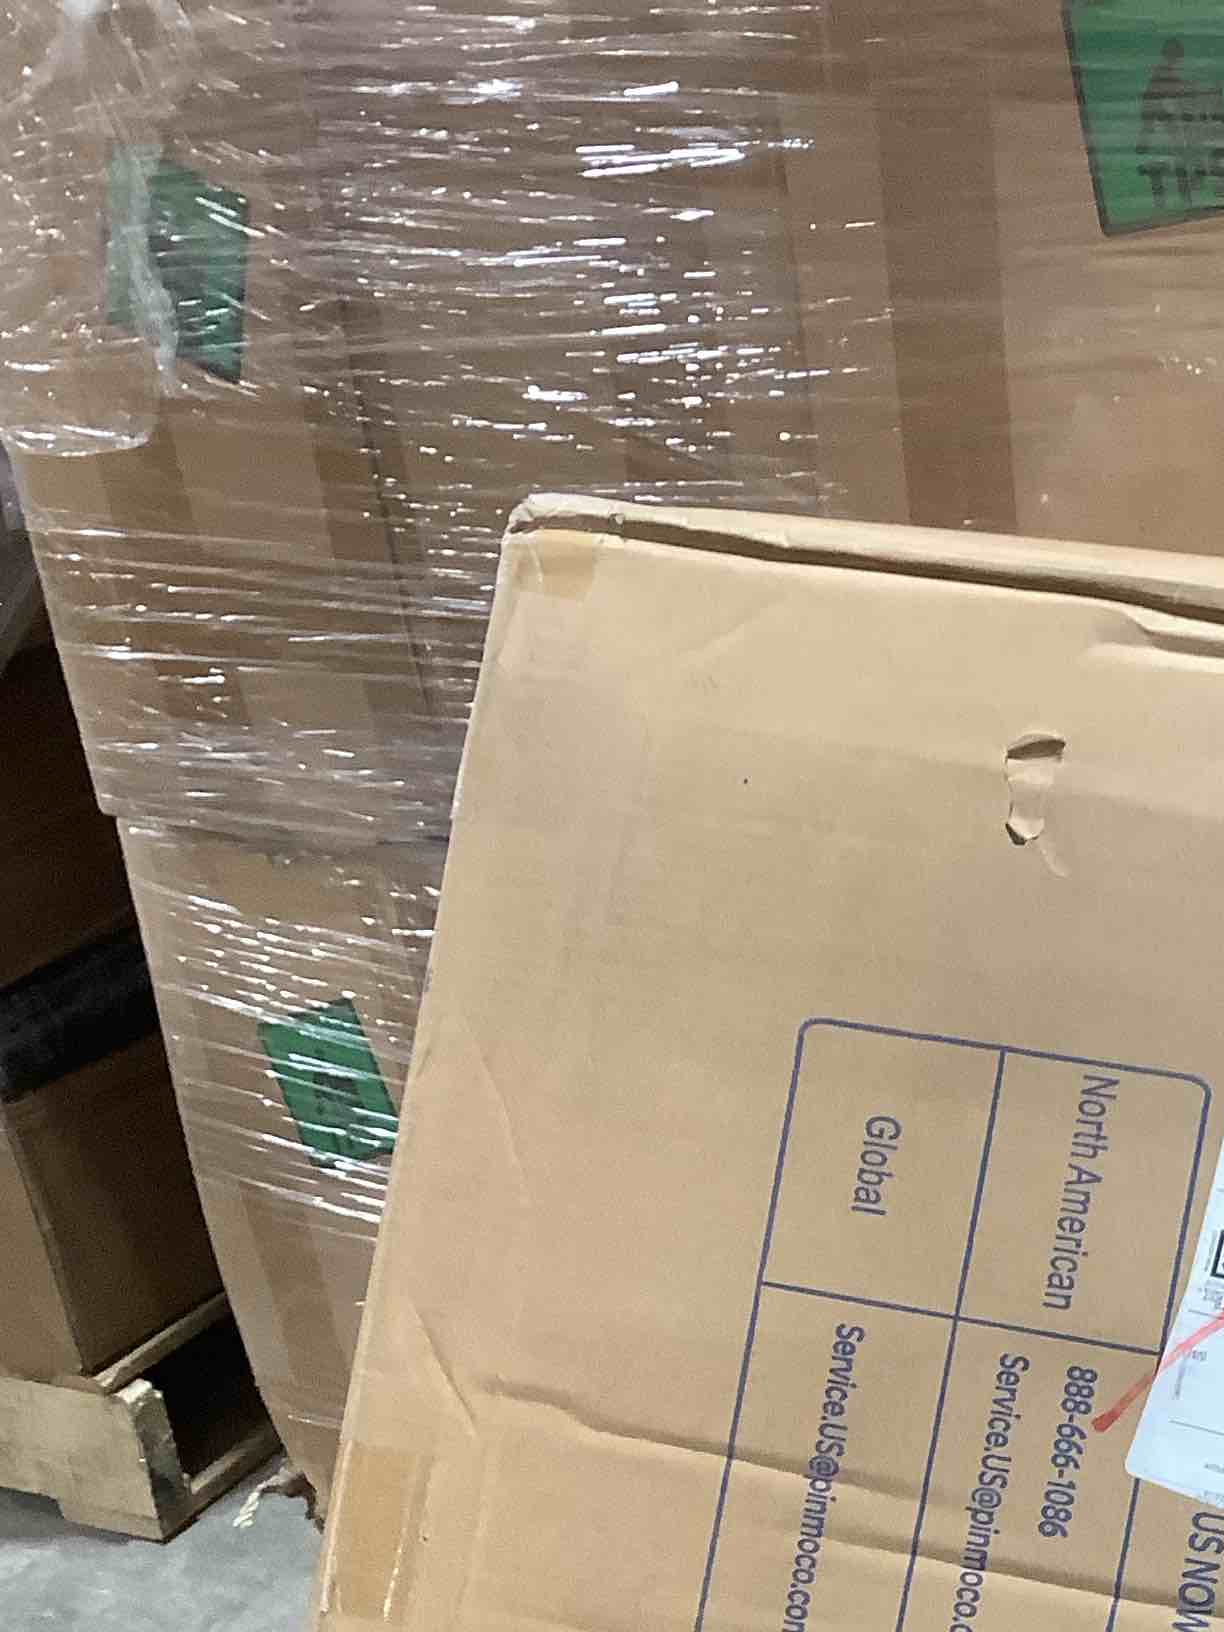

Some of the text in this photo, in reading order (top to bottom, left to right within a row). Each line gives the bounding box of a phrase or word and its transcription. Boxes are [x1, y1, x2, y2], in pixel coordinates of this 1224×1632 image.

[851, 1115, 901, 1218] Global
[1043, 1074, 1120, 1311] North American
[1038, 1365, 1100, 1540] 888-666-1086
